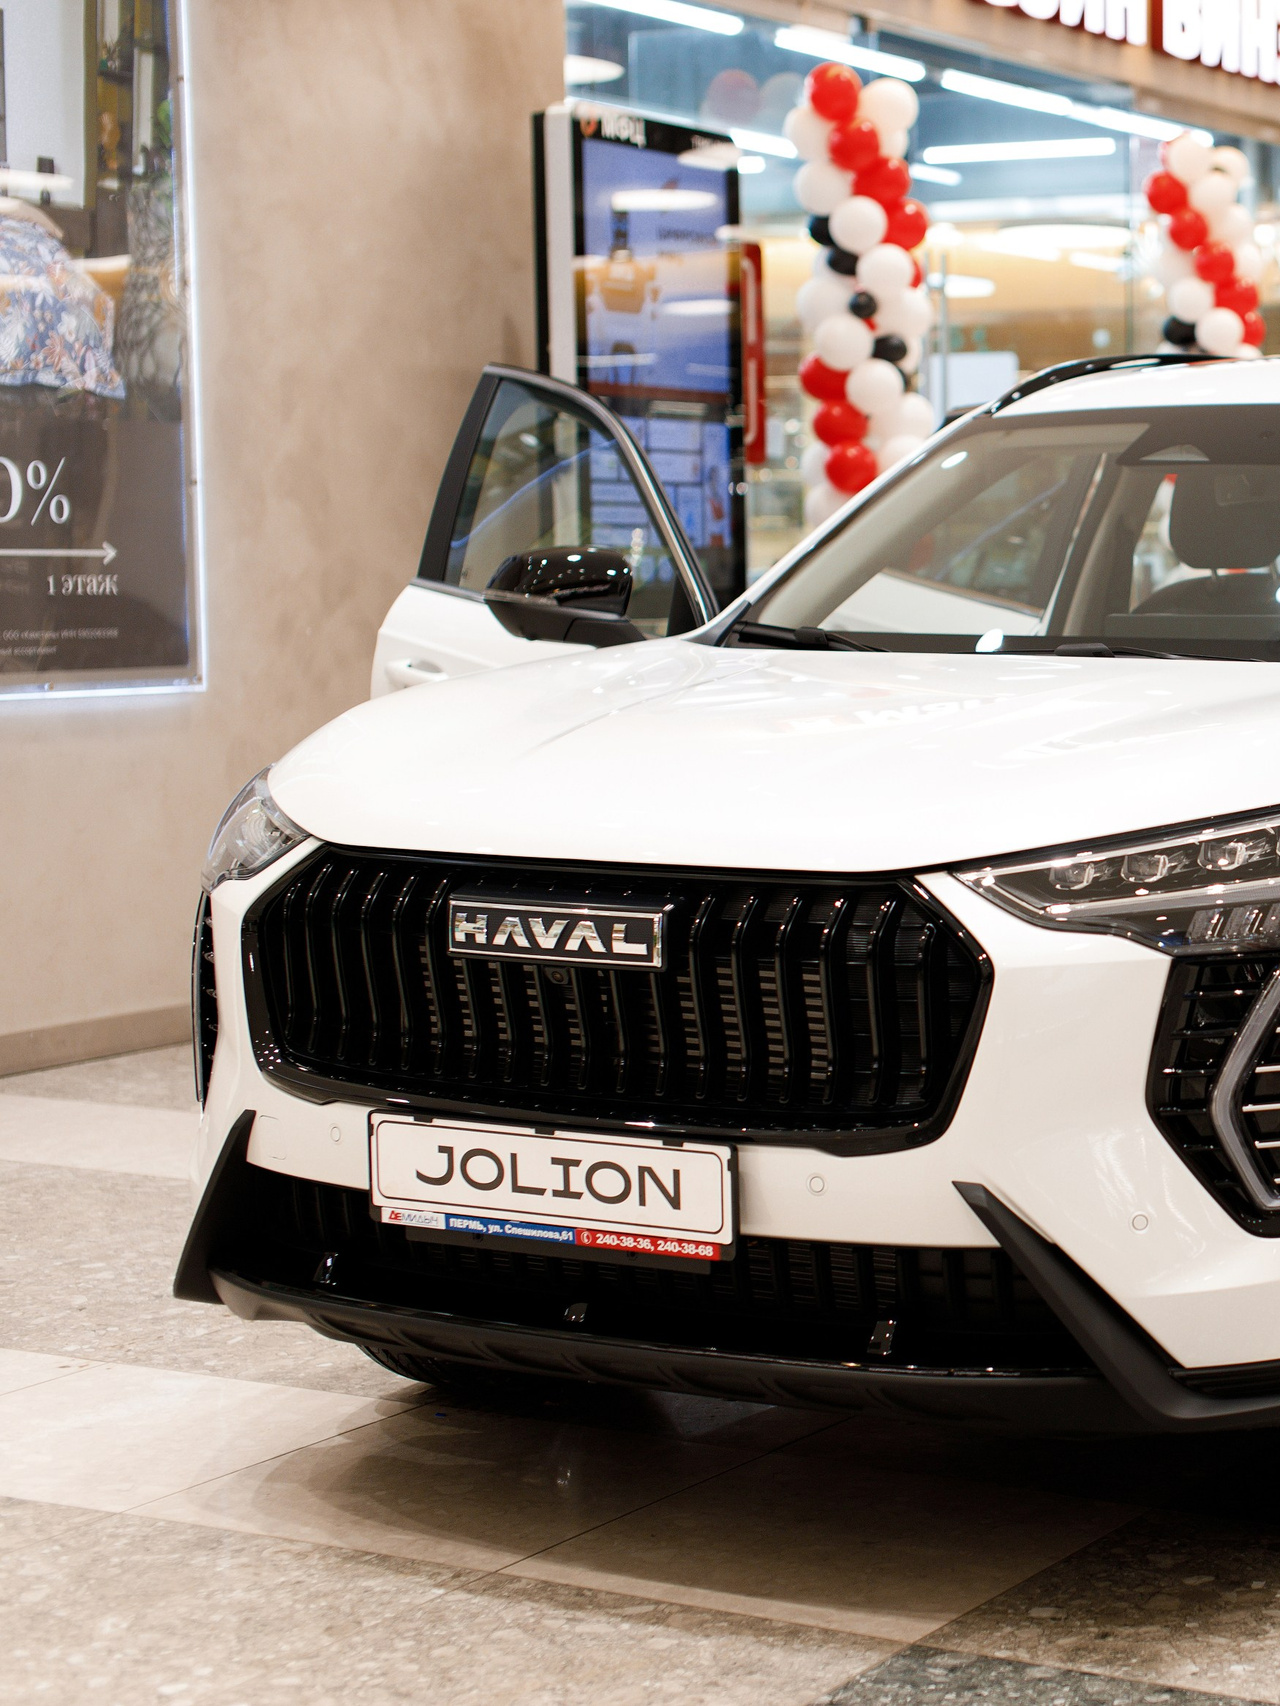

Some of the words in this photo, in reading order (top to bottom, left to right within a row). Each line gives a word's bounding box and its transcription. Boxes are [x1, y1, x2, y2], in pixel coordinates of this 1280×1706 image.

[47, 574, 56, 596] 1
[454, 912, 648, 955] HAVAL
[415, 1144, 682, 1211] JOLION
[449, 1218, 487, 1233] ПЕРМЬ,
[488, 1224, 503, 1234] ул.
[595, 1233, 655, 1251] 240-38-36,
[656, 1240, 714, 1257] 240-38-68
